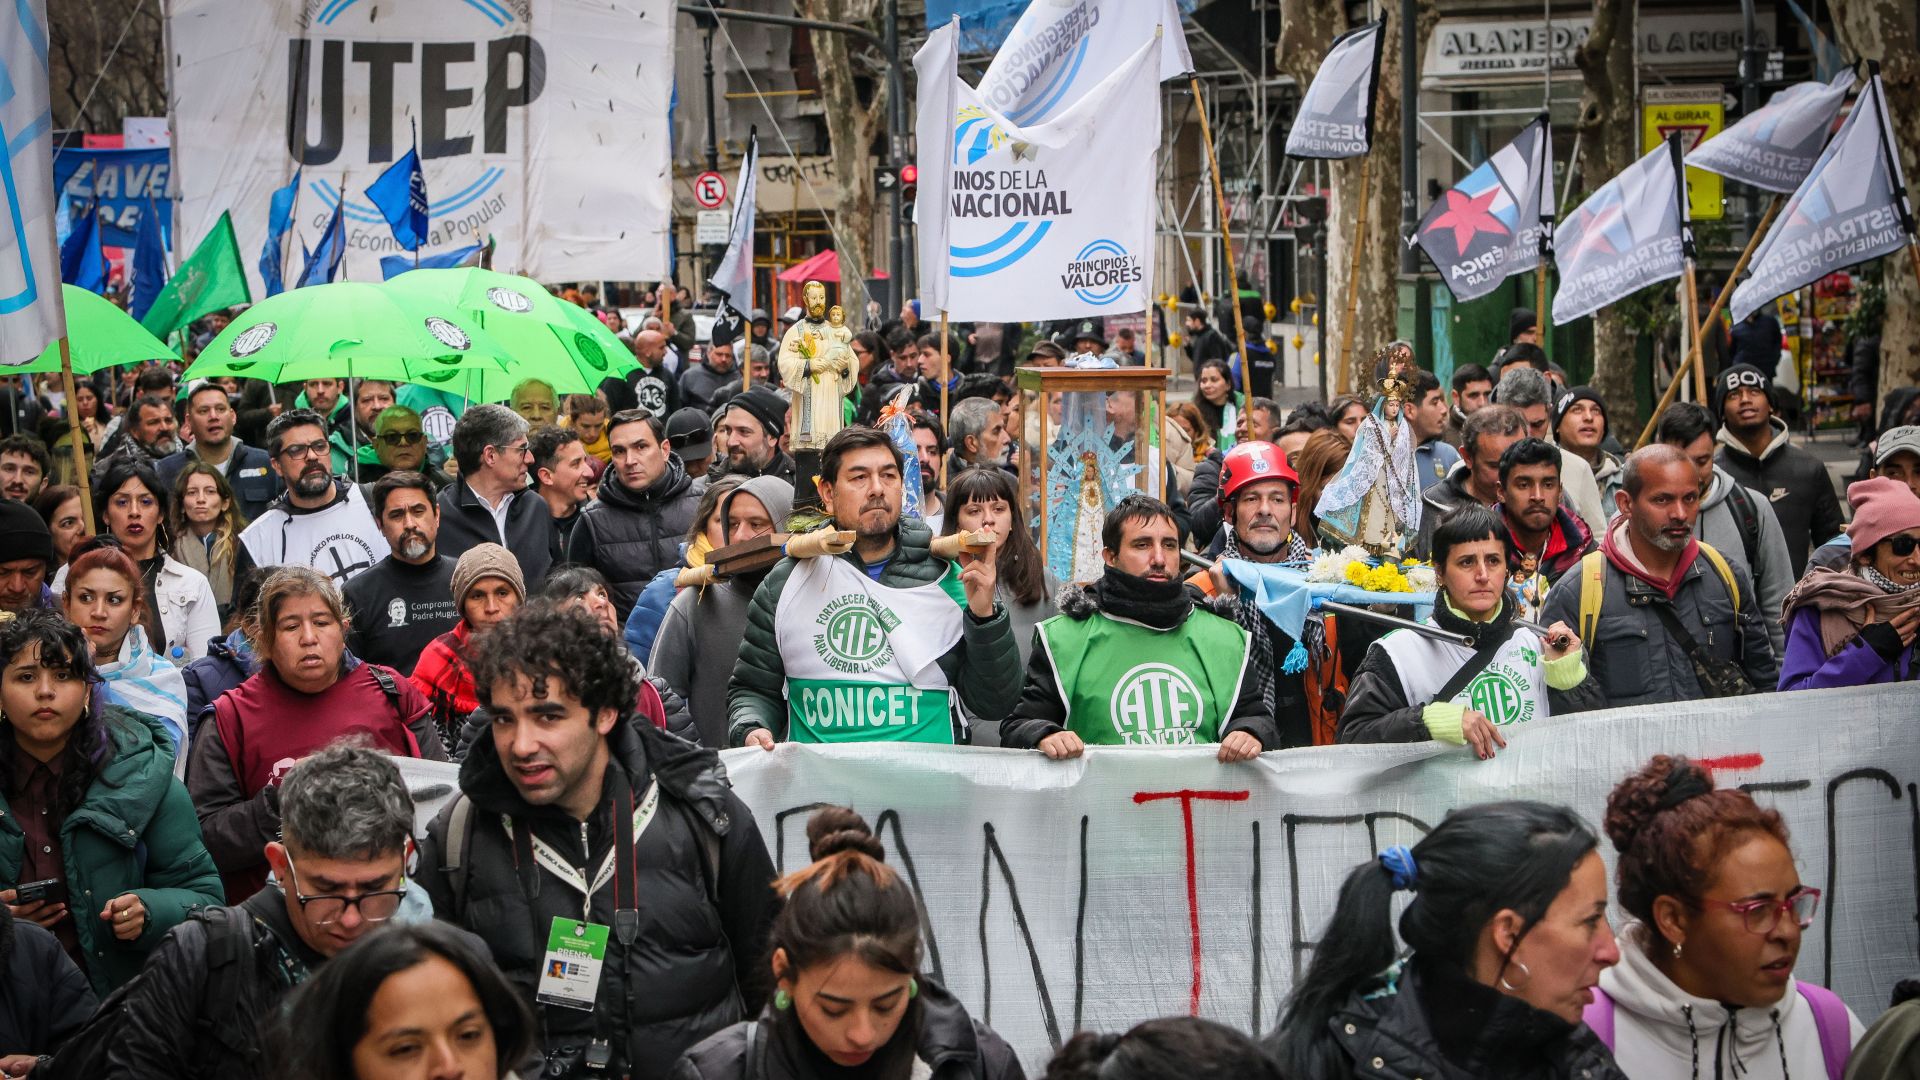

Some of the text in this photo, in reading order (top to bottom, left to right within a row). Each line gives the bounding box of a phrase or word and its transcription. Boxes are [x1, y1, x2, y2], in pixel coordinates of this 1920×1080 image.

[1441, 26, 1590, 57] ALAMEDA
[286, 35, 547, 165] UTEP
[1663, 88, 1720, 98] CONDUCTOR
[1655, 111, 1668, 120] AL
[952, 169, 1048, 191] INOS DE LA
[442, 192, 507, 241] Popular
[951, 190, 1072, 218] NACIONAL
[1061, 266, 1142, 289] VALORES
[1067, 255, 1137, 274] PRINCIPIOS Y
[1726, 371, 1766, 390] BOY
[326, 533, 341, 544] POR
[341, 533, 354, 541] LOS
[354, 537, 376, 564] DERECHO
[411, 600, 455, 612] Compromis
[412, 609, 434, 621] Padre
[815, 593, 865, 626] FORTALECER
[832, 611, 880, 656] ATE
[813, 633, 894, 674] PARA LIBERAR LA NACIO
[1490, 662, 1531, 692] EL ESTADO
[802, 686, 923, 727] CONICET
[1119, 671, 1190, 732] ATE
[1472, 678, 1516, 725] ATE
[1520, 699, 1535, 723] ACION
[556, 862, 574, 877] NEGRA
[556, 947, 593, 961] PRENSA
